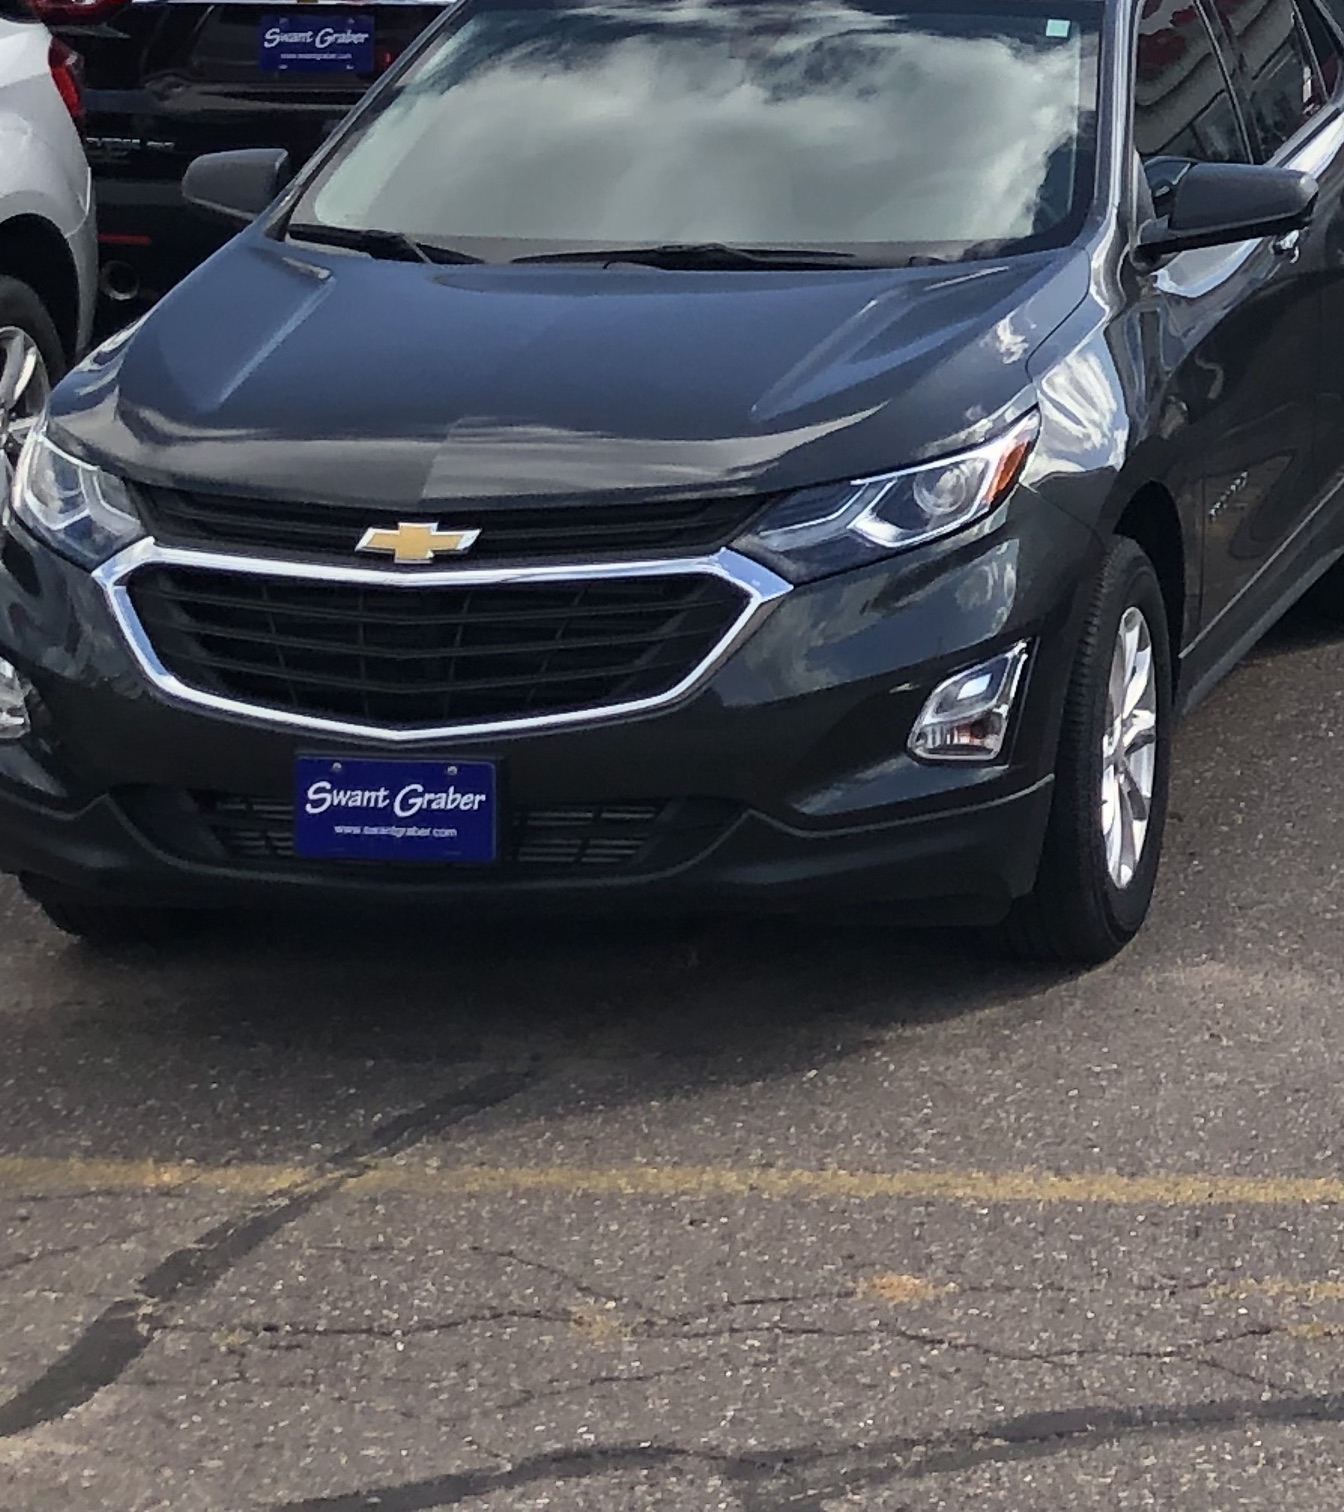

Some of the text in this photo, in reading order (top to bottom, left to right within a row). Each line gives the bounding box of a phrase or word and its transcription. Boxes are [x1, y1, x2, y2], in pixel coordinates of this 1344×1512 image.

[263, 28, 369, 48] Swant Graber
[305, 780, 486, 818] Swant Graber
